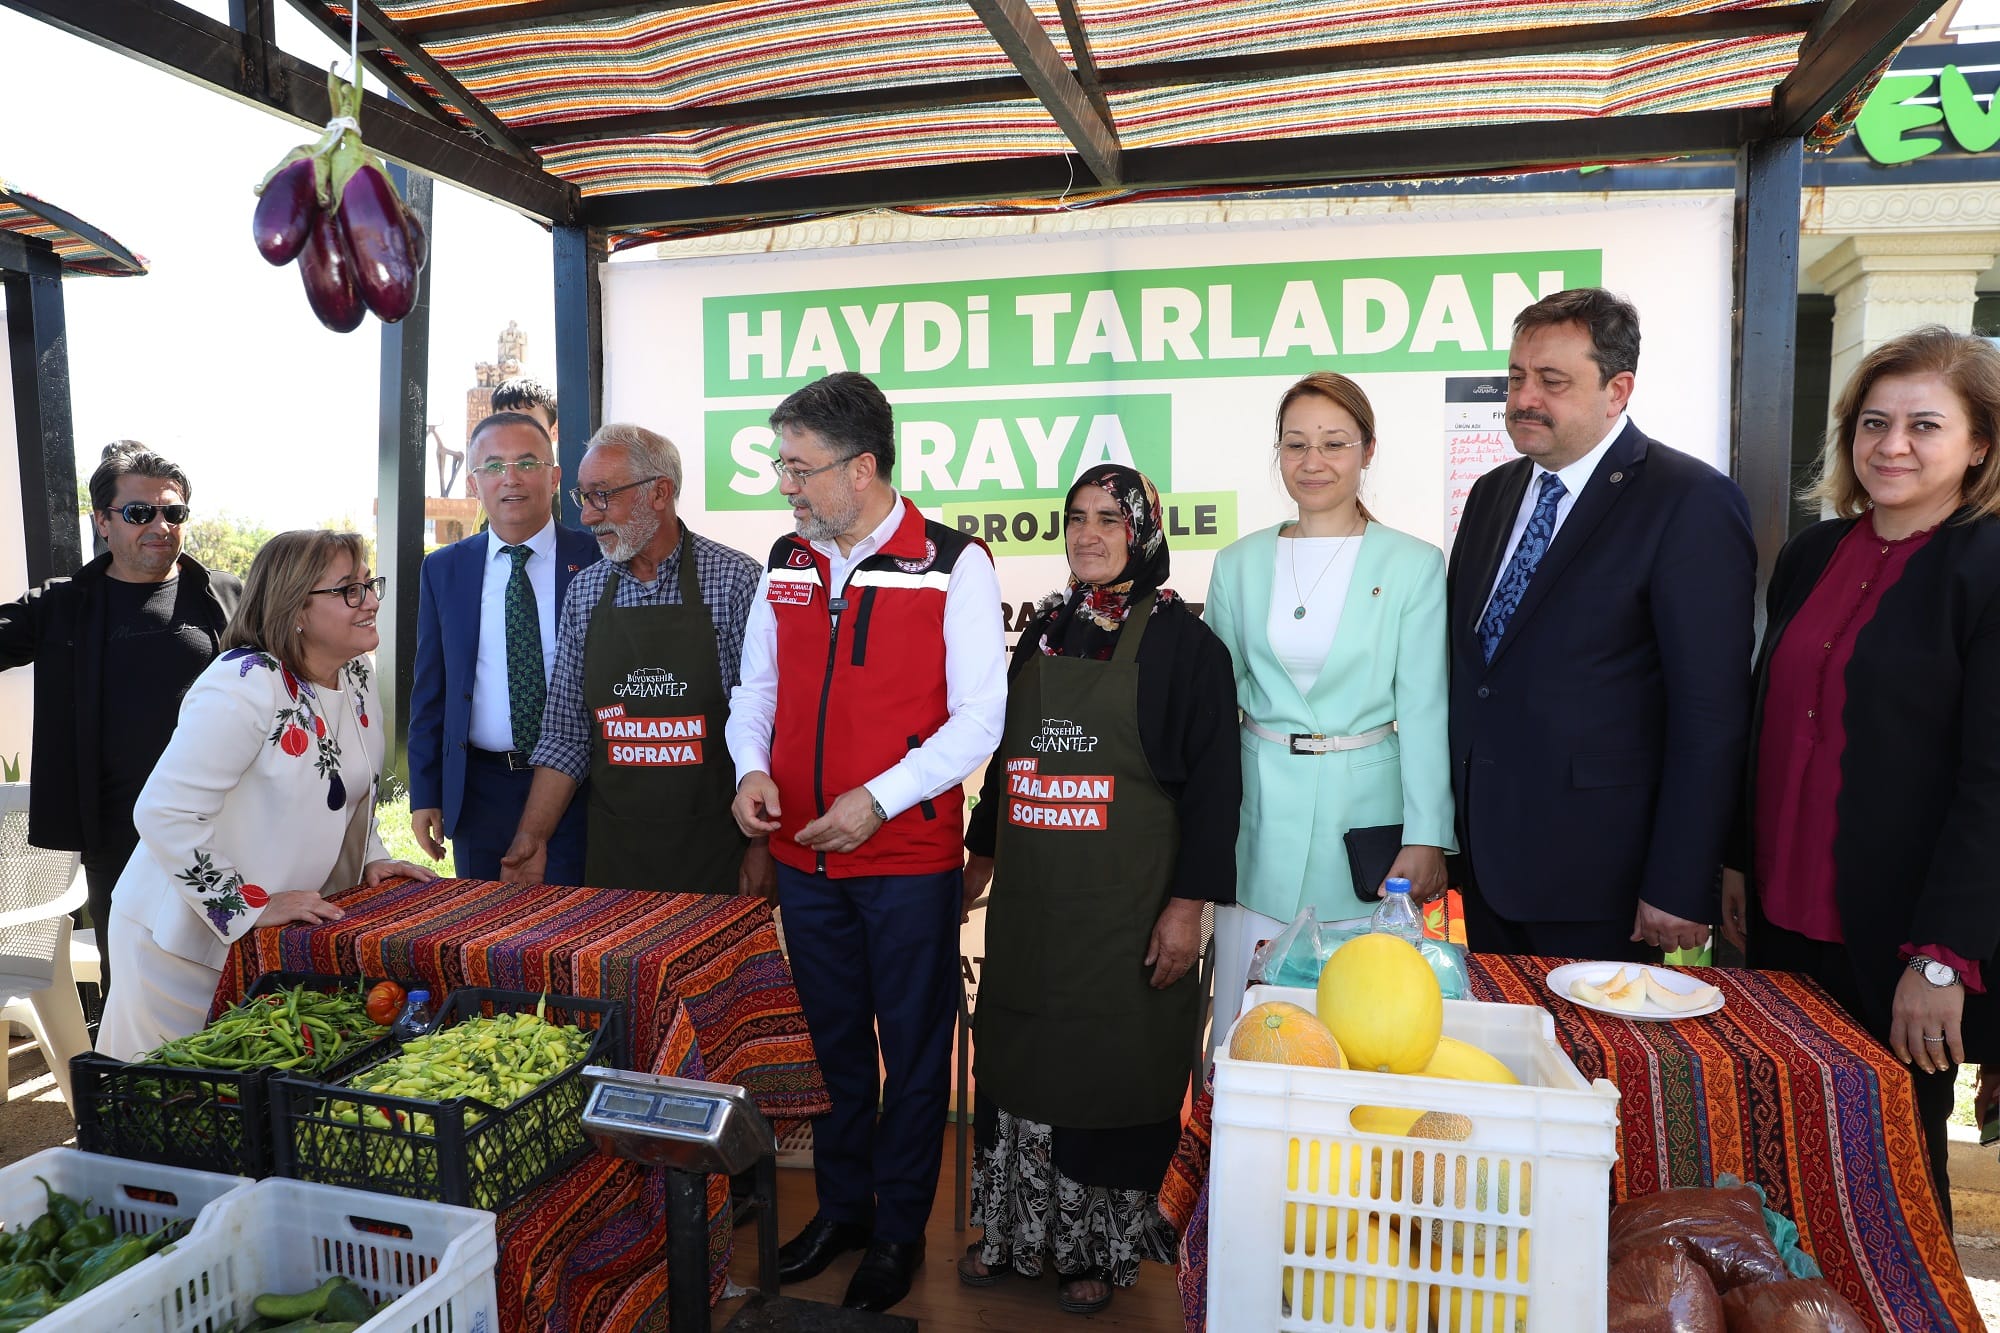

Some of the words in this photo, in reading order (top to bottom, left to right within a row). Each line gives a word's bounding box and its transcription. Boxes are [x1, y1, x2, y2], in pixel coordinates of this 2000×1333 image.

[1015, 269, 1565, 367] TARLADAN
[727, 414, 1136, 496] SRAYA
[606, 719, 702, 738] TARLADAN
[612, 745, 697, 763] SOFRAYA
[1012, 774, 1109, 799] TARLADAN
[1012, 803, 1100, 827] SOFRAYA
